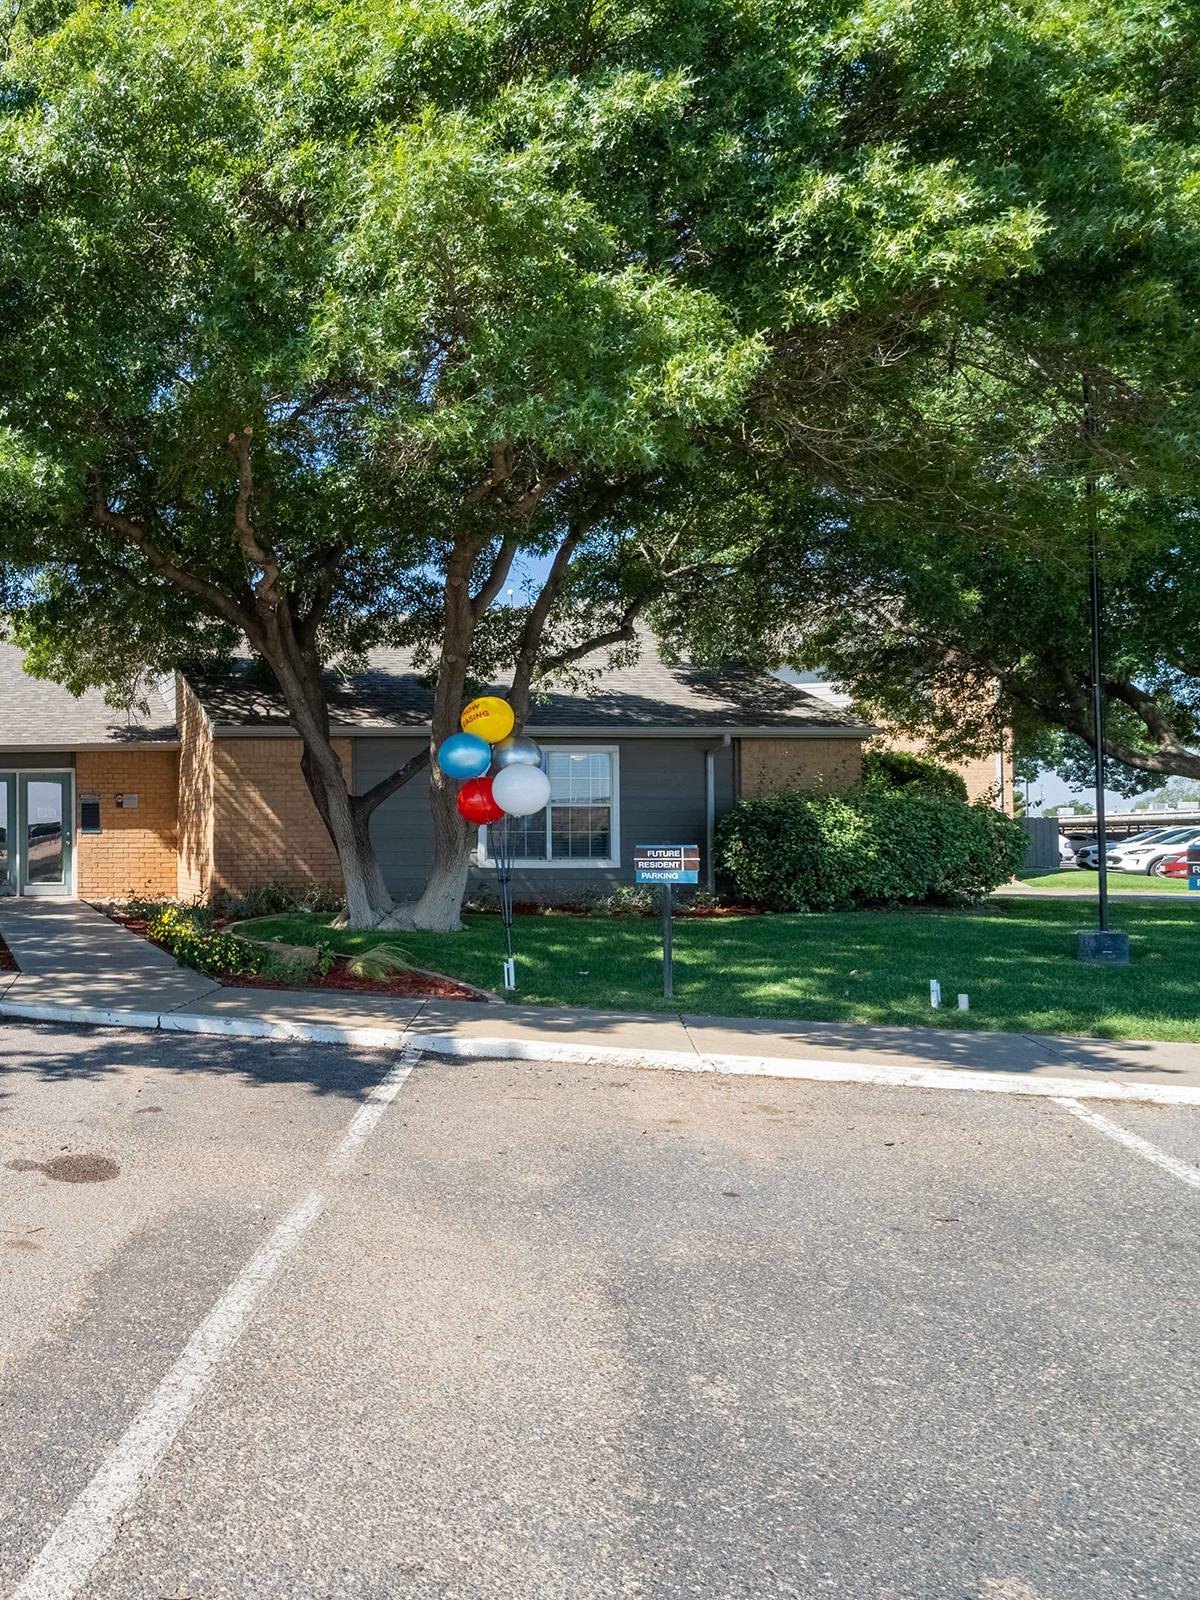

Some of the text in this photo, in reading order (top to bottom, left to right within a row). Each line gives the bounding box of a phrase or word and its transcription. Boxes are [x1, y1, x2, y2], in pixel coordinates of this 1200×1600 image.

[463, 710, 490, 728] EASING
[647, 850, 681, 858] FUTURE
[638, 861, 681, 869] RESIDENT
[641, 872, 679, 880] PARKING
